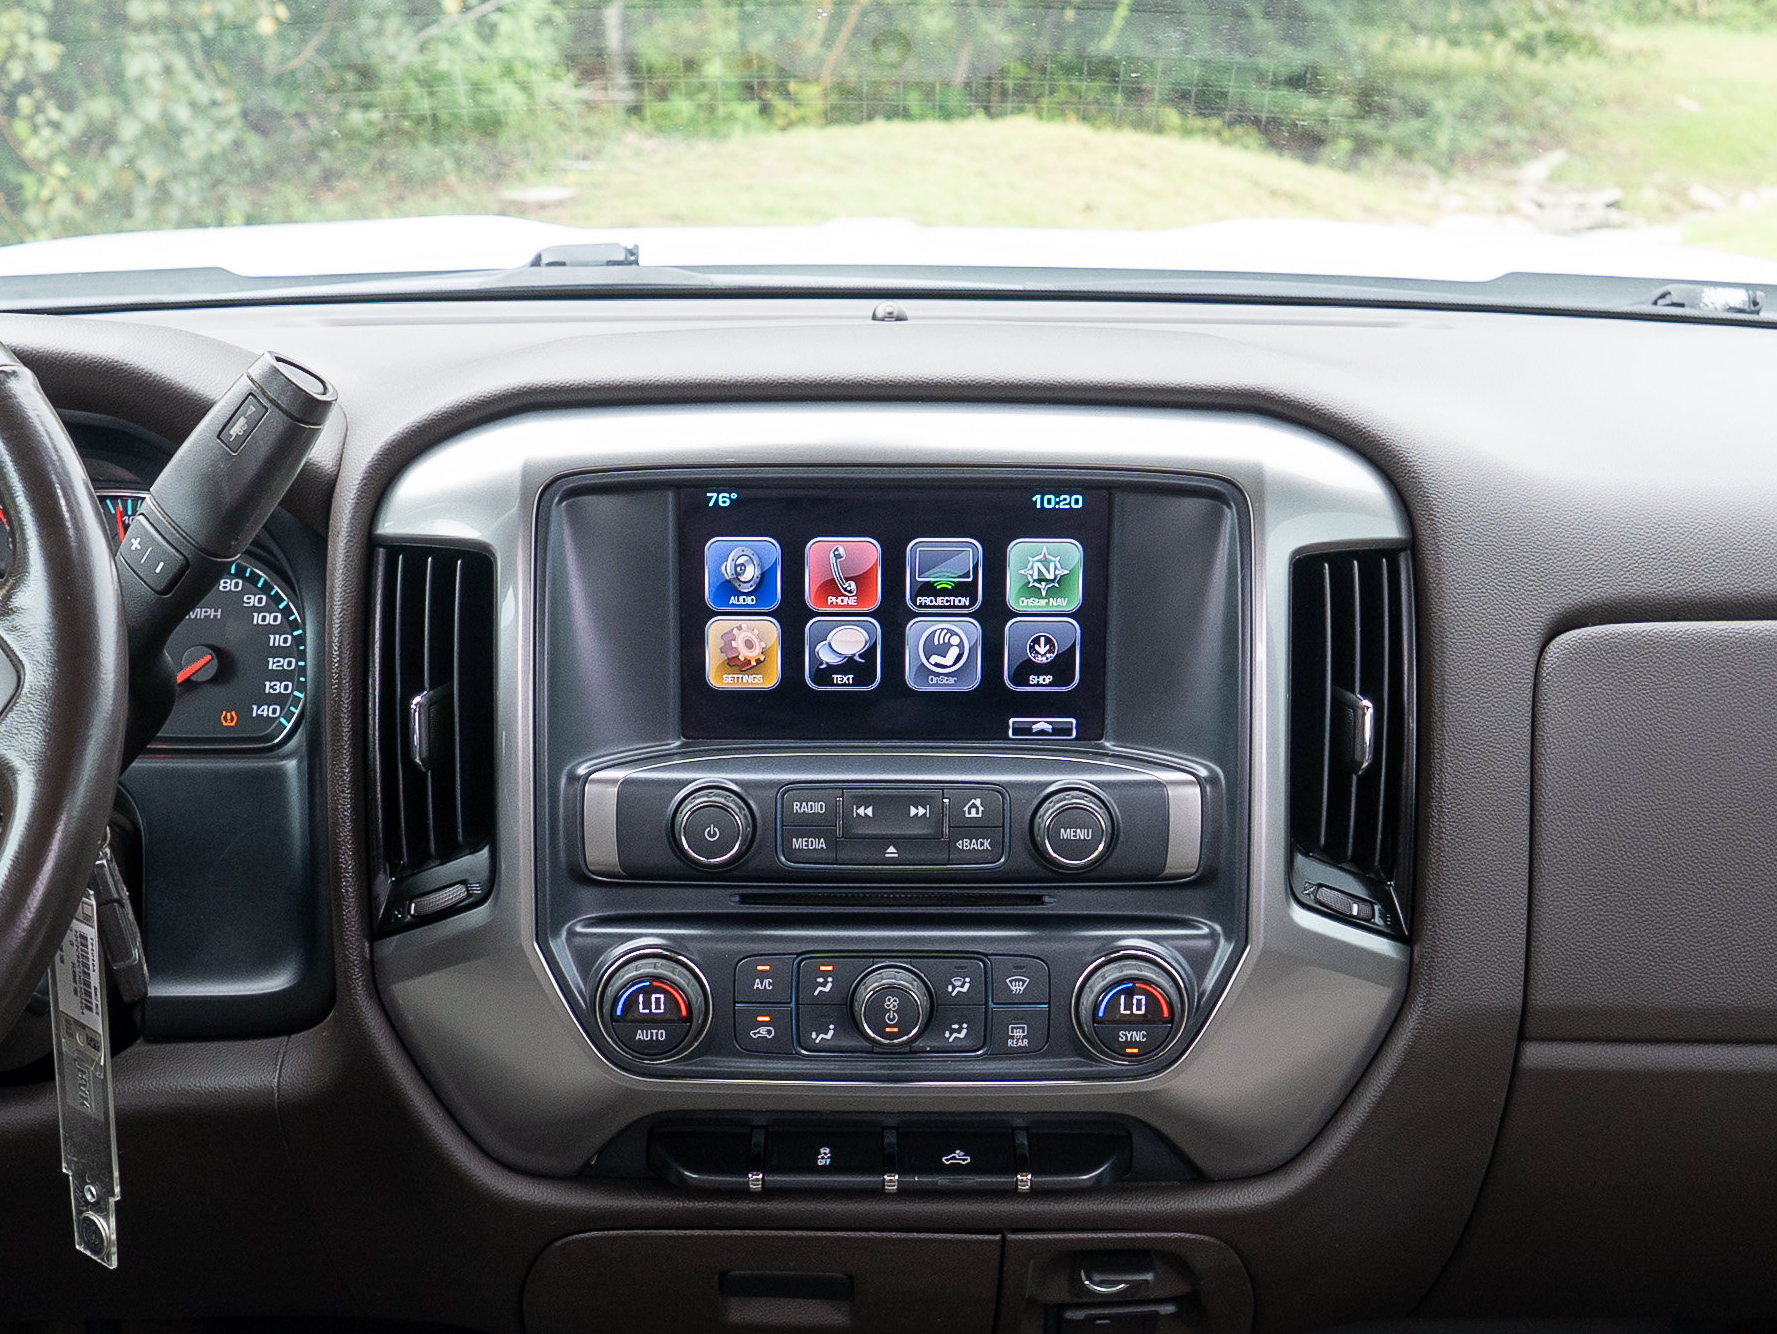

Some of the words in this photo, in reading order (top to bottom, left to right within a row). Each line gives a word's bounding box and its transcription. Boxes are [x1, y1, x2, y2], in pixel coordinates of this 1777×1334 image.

[706, 492, 738, 507] 76°
[1031, 494, 1083, 509] 10:20
[218, 578, 243, 592] 80
[243, 594, 266, 607] 90
[729, 595, 756, 605] AUDIO
[827, 596, 858, 606] PHONE
[916, 596, 970, 606] PROJECTION
[1019, 597, 1048, 607] OnStar
[1049, 597, 1069, 607] NAV
[185, 609, 221, 619] MPH
[252, 612, 282, 626] 100
[269, 634, 292, 647] 110
[267, 657, 296, 670] 120
[722, 674, 763, 684] SETTINGS
[832, 674, 854, 684] TEXT
[928, 675, 957, 684] OnStar
[1029, 675, 1053, 685] SHOP
[264, 681, 292, 694] 130
[251, 704, 281, 717] 140
[793, 801, 826, 814] RADIO
[1060, 828, 1092, 841] MENU
[792, 838, 826, 850] MEDIA
[963, 838, 992, 851] BACK
[753, 978, 773, 990] A/C
[638, 993, 665, 1013] LO
[1119, 994, 1146, 1015] LO
[635, 1029, 666, 1041] AUTO
[1118, 1030, 1147, 1042] SYNC
[1007, 1038, 1029, 1047] REAR
[817, 1158, 831, 1166] OFF
